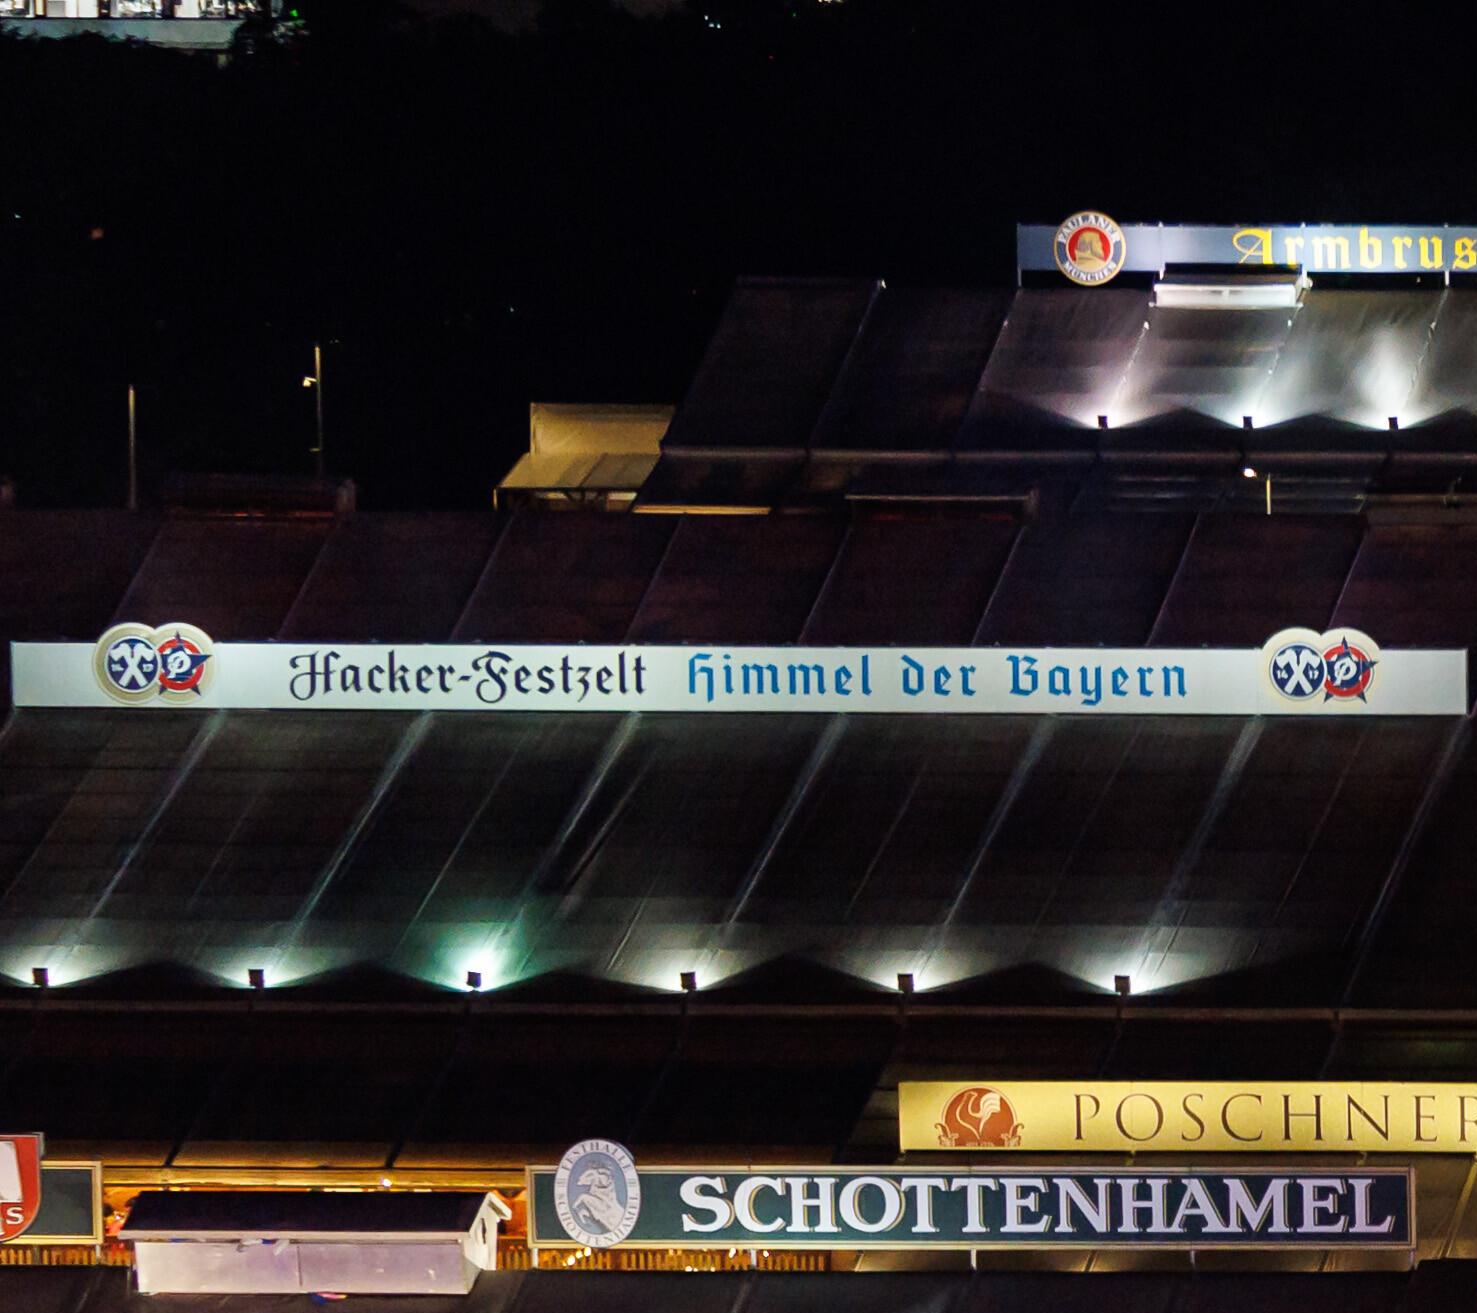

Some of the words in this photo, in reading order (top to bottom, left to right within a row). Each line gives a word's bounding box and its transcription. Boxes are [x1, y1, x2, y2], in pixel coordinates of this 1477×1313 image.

[288, 649, 649, 697] Hacker-Festzelt
[688, 651, 874, 698] Himmel
[899, 652, 978, 698] der
[1009, 653, 1190, 705] Bayern
[679, 1176, 1396, 1236] SCHOTTENHAMEL
